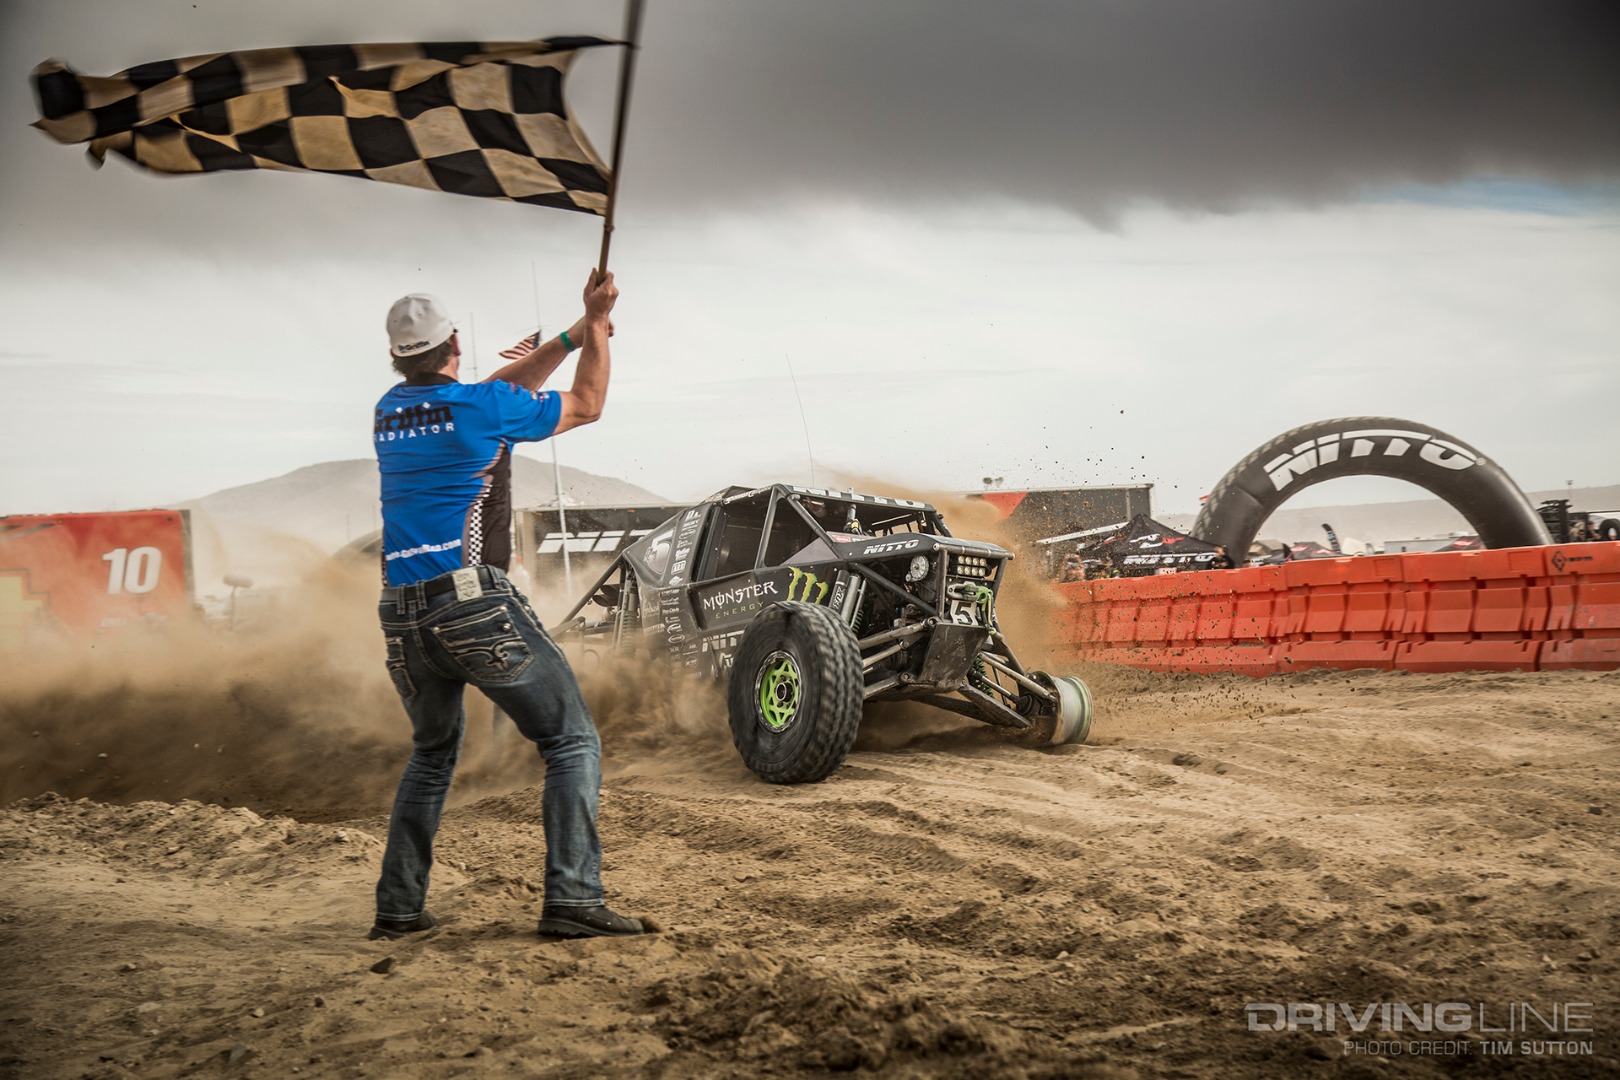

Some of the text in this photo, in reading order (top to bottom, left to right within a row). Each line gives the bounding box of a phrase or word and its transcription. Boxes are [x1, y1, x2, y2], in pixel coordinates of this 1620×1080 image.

[1263, 429, 1477, 491] NITTO
[863, 539, 920, 555] NITTO
[102, 545, 163, 594] 10
[703, 581, 778, 611] MONSTER
[715, 602, 764, 619] ENERGY
[954, 602, 974, 626] 5
